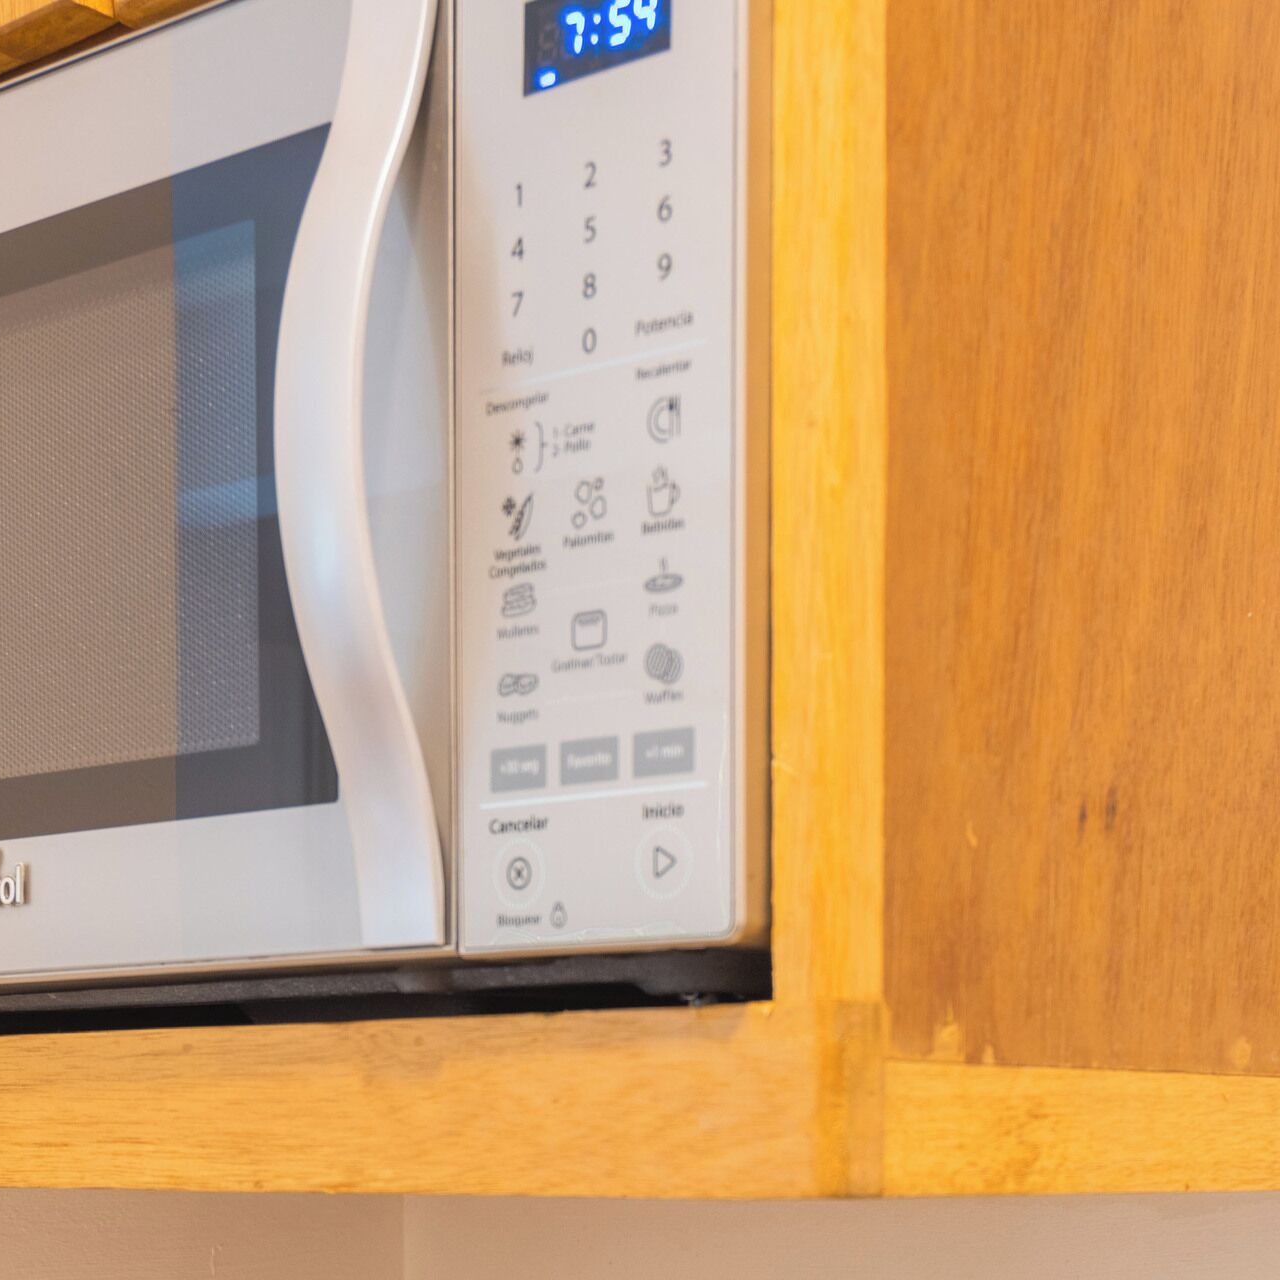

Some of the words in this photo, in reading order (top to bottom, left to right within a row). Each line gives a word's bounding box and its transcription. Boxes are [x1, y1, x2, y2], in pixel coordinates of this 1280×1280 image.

[565, 0, 658, 54] 7:54
[659, 138, 672, 167] 3
[583, 161, 597, 189] 2
[515, 183, 523, 207] 1
[657, 195, 673, 223] 6
[583, 216, 597, 243] 5
[511, 238, 524, 260] 4
[657, 253, 673, 281] 9
[582, 273, 597, 300] 8
[511, 292, 524, 317] 7
[634, 311, 694, 337] Potencia
[582, 328, 597, 353] 0
[502, 348, 535, 368] Reloj
[636, 359, 693, 381] Recalentar
[485, 391, 550, 416] Descongelar
[641, 517, 685, 535] Bebidas
[562, 530, 615, 549] Palomitas
[493, 543, 542, 562] Vegetales
[488, 559, 548, 580] Congelados
[488, 814, 549, 834] Cancelar
[641, 802, 685, 821] Inicio
